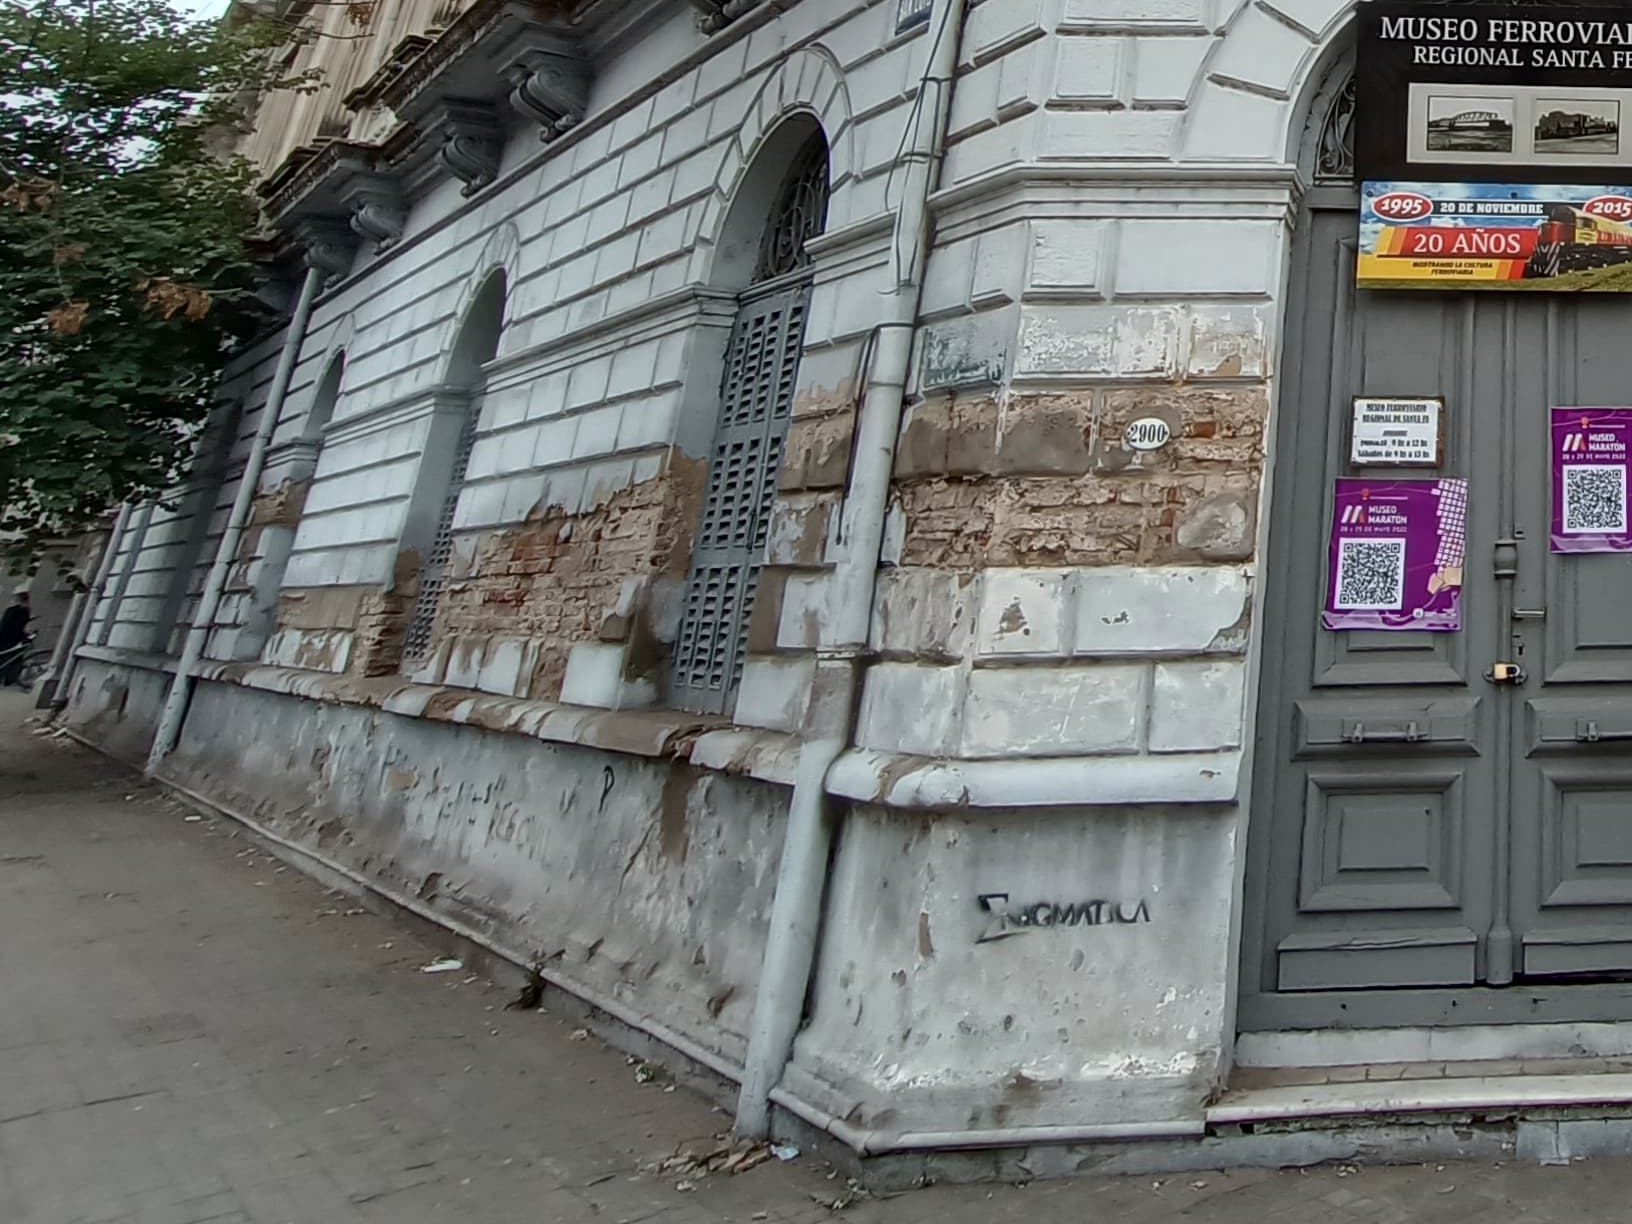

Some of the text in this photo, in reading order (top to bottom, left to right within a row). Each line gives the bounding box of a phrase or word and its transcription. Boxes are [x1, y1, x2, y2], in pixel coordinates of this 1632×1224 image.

[1380, 17, 1478, 40] MUSEO
[1413, 46, 1524, 66] REGIONAL
[1531, 49, 1605, 68] SANTA
[1381, 198, 1424, 214] 1995
[1440, 202, 1544, 214] 20 DE NOVIEMBRE
[1592, 202, 1632, 217] 2015
[1413, 228, 1521, 254] 20 AÑOS
[1130, 424, 1166, 443] 2900
[1589, 433, 1615, 441] MUSEO
[1369, 506, 1397, 514] MUSEO
